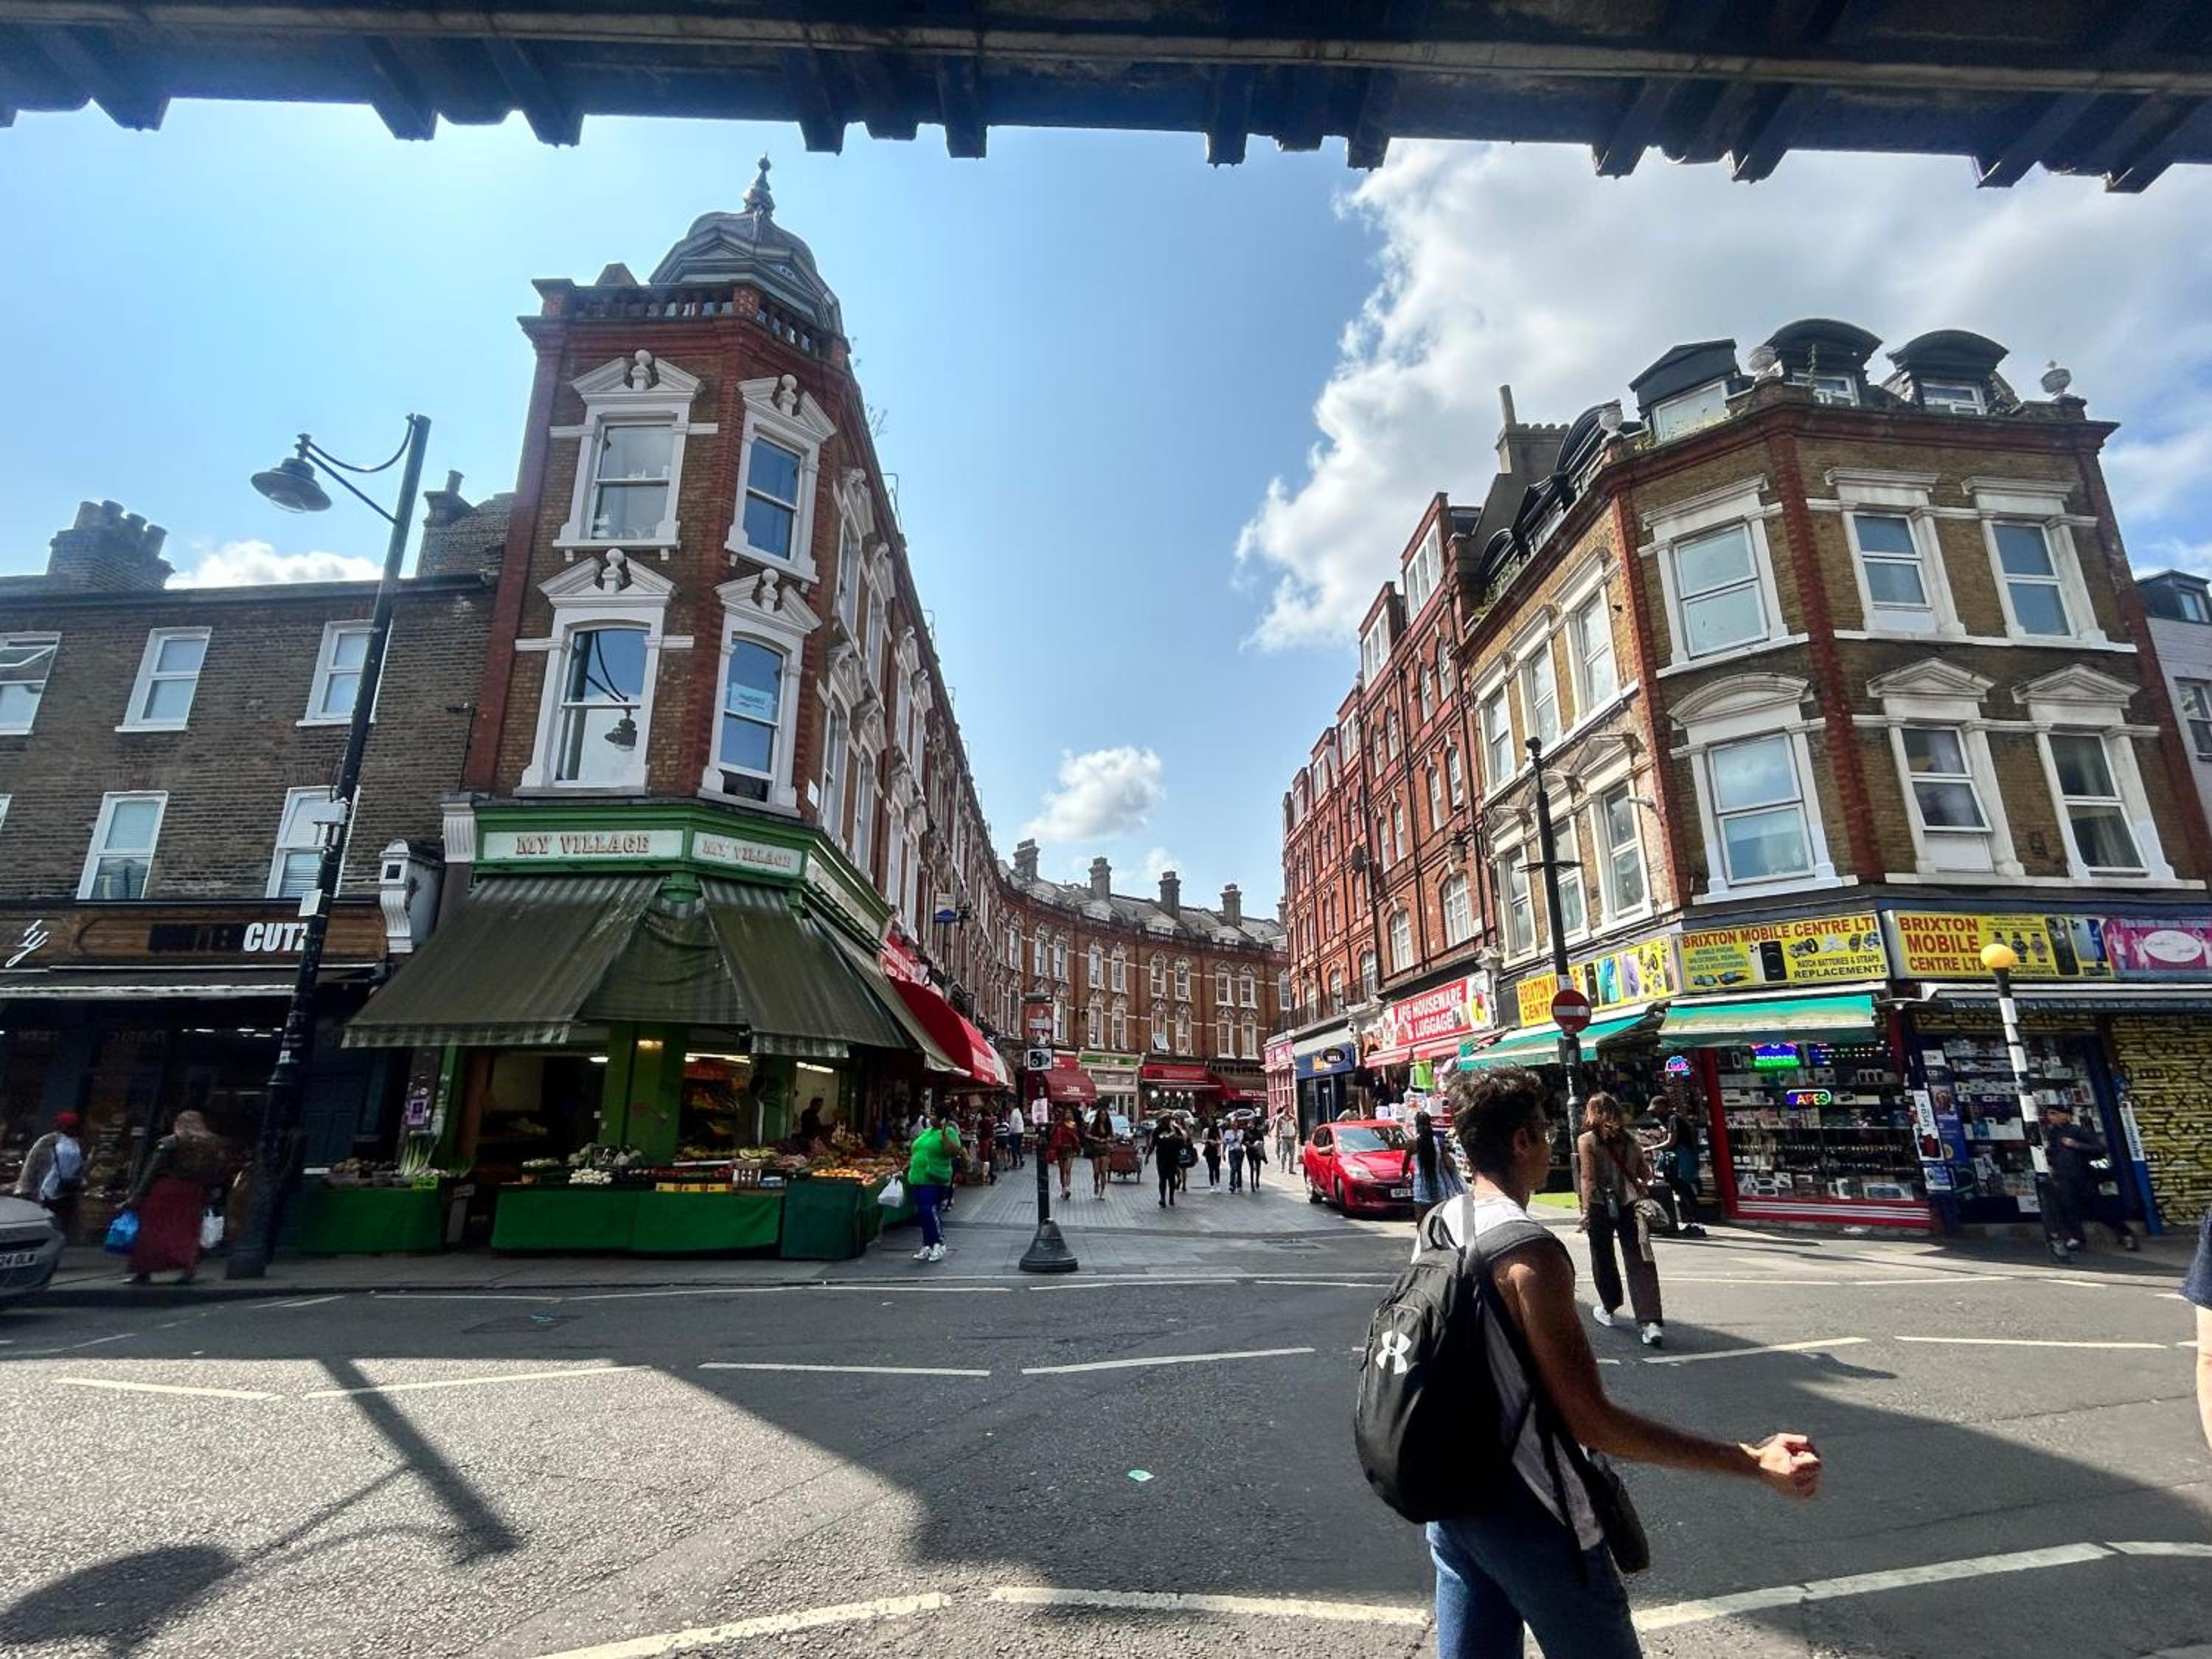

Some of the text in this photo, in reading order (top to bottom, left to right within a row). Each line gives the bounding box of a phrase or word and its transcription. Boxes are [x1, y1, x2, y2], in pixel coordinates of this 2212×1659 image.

[517, 833, 650, 854] MY VILLAGE
[734, 846, 792, 868] VILLAGE
[1683, 930, 1737, 949] BRIXTON
[1741, 925, 1790, 944] MOBILE
[1794, 919, 1851, 940] CENTRE
[1899, 917, 1979, 931] BRIXTON
[1906, 933, 1981, 953] MOBILE
[1794, 963, 1887, 979] REPLACEMENTS
[1909, 956, 1962, 971] CENTRE
[1412, 985, 1462, 1019] HOUSEWARE
[1524, 1001, 1550, 1021] CENTR
[1414, 1011, 1453, 1039] LUGGAGE
